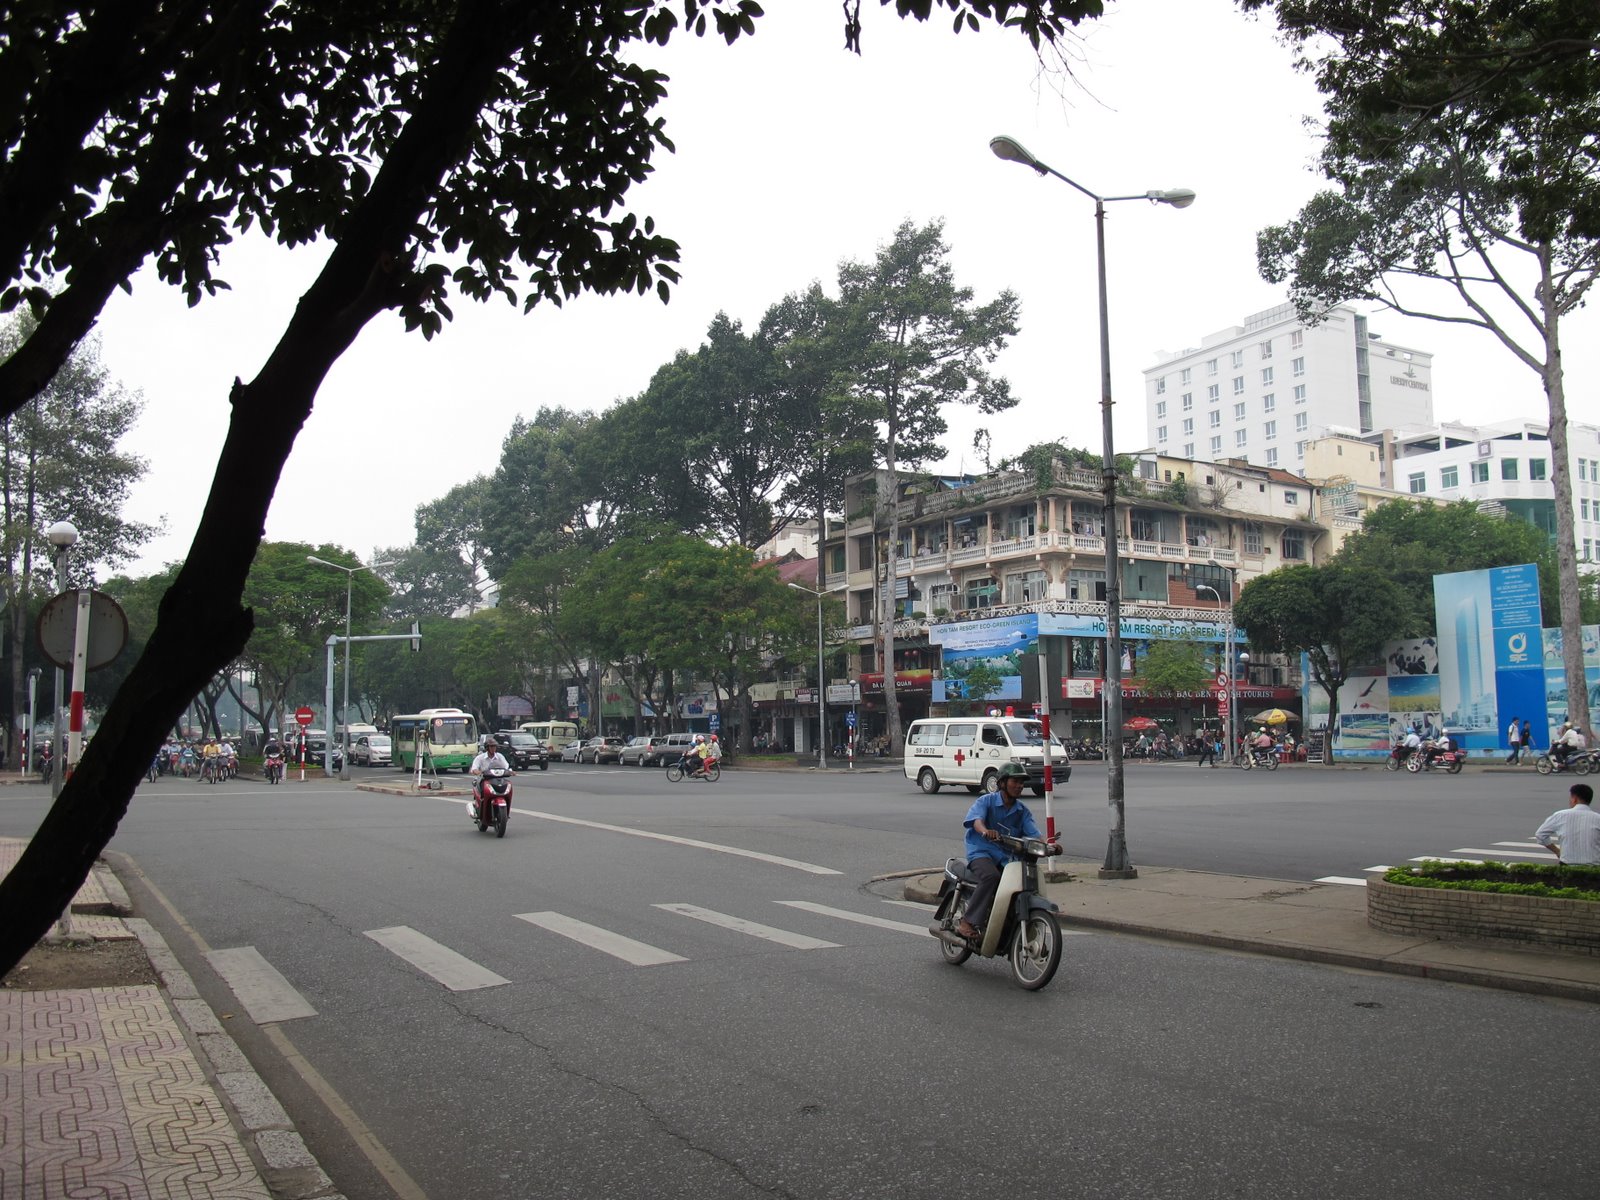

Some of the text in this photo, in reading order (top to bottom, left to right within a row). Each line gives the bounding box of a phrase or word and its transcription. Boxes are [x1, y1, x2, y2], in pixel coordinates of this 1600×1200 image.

[959, 624, 979, 632] RESORT
[979, 622, 1010, 630] ECO-GREEN
[1010, 618, 1031, 626] ISLAND
[1092, 622, 1107, 633] HO
[1134, 624, 1168, 635] RESORT
[1169, 626, 1217, 638] ECO-GREEN
[1243, 690, 1274, 699] TOURIST
[711, 714, 717, 722] P
